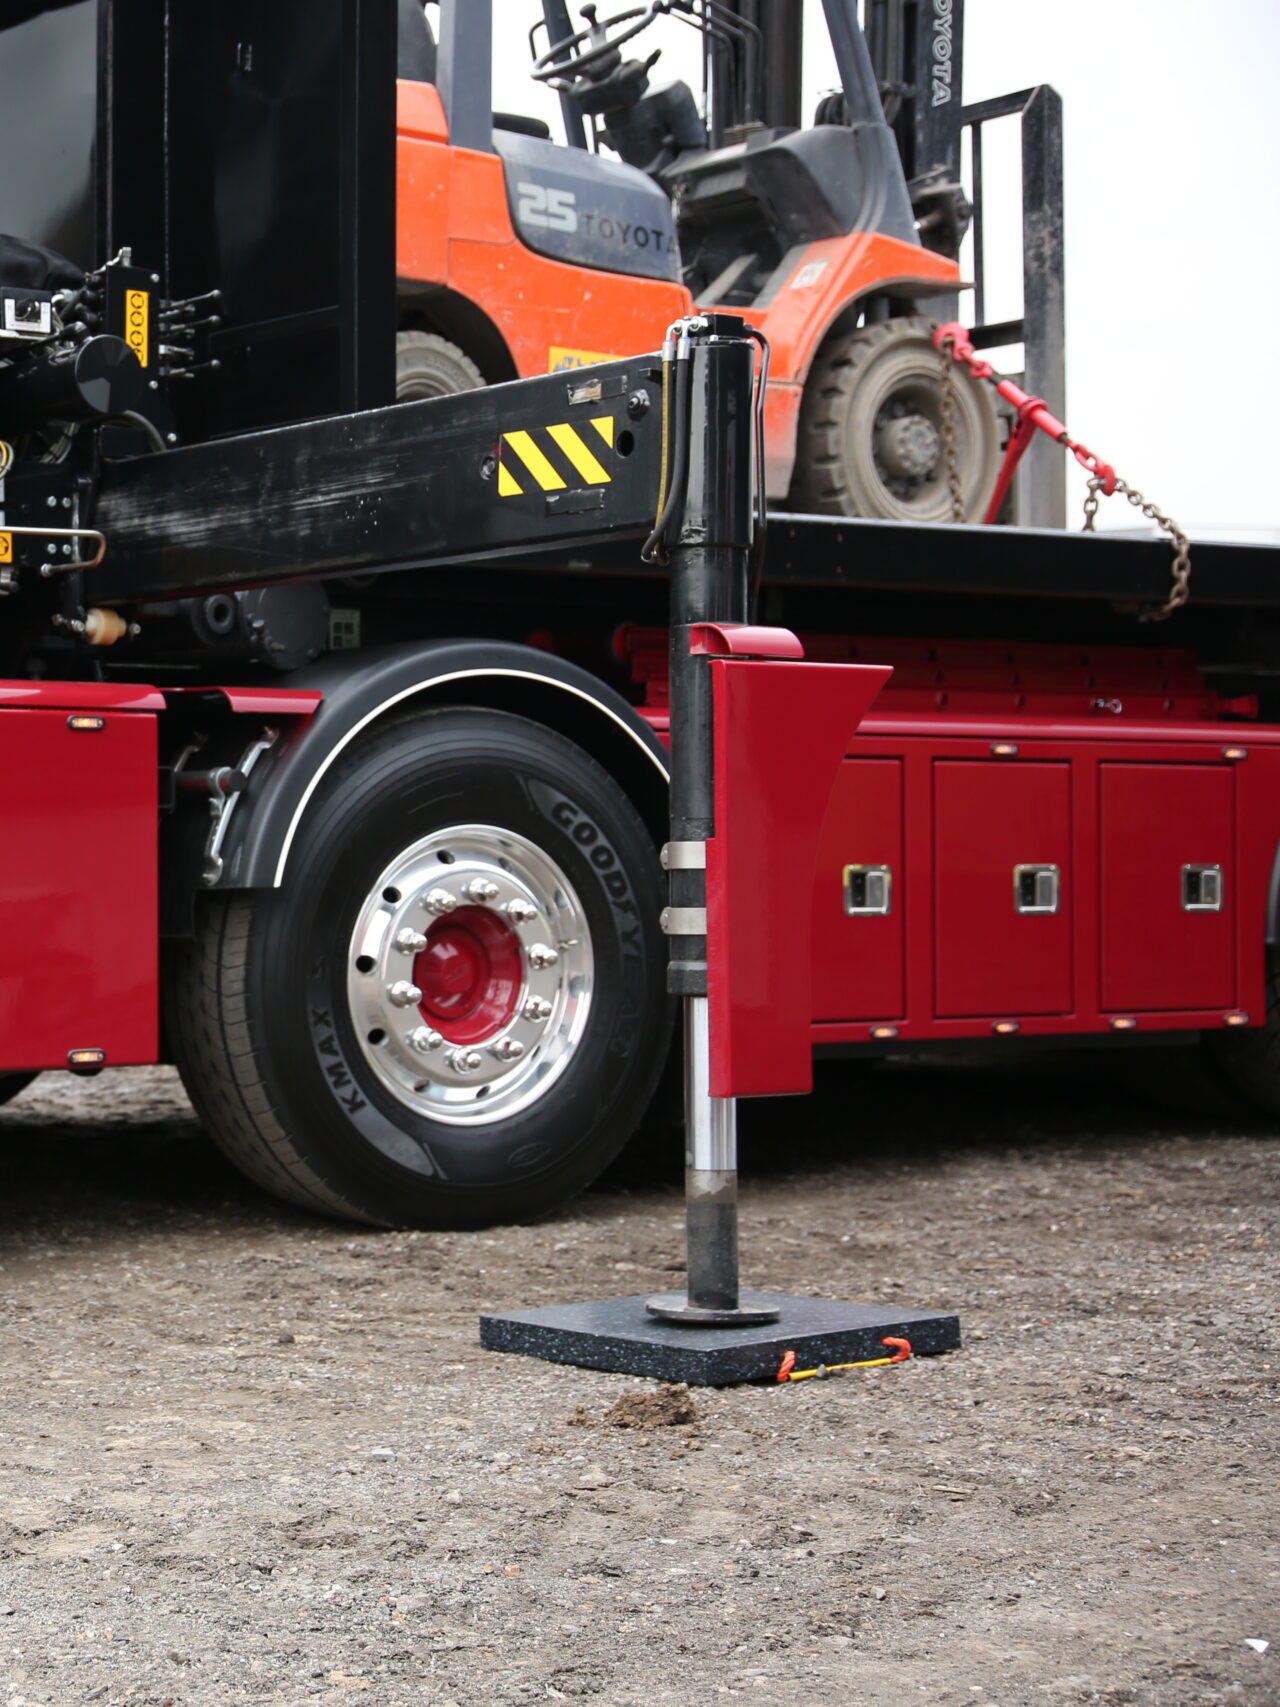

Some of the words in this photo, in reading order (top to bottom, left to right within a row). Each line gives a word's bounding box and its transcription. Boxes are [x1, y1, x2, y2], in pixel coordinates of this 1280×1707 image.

[931, 0, 953, 107] OYOTA
[517, 182, 578, 234] 25
[580, 212, 677, 253] TOYOTA
[311, 1008, 368, 1115] KMAX
